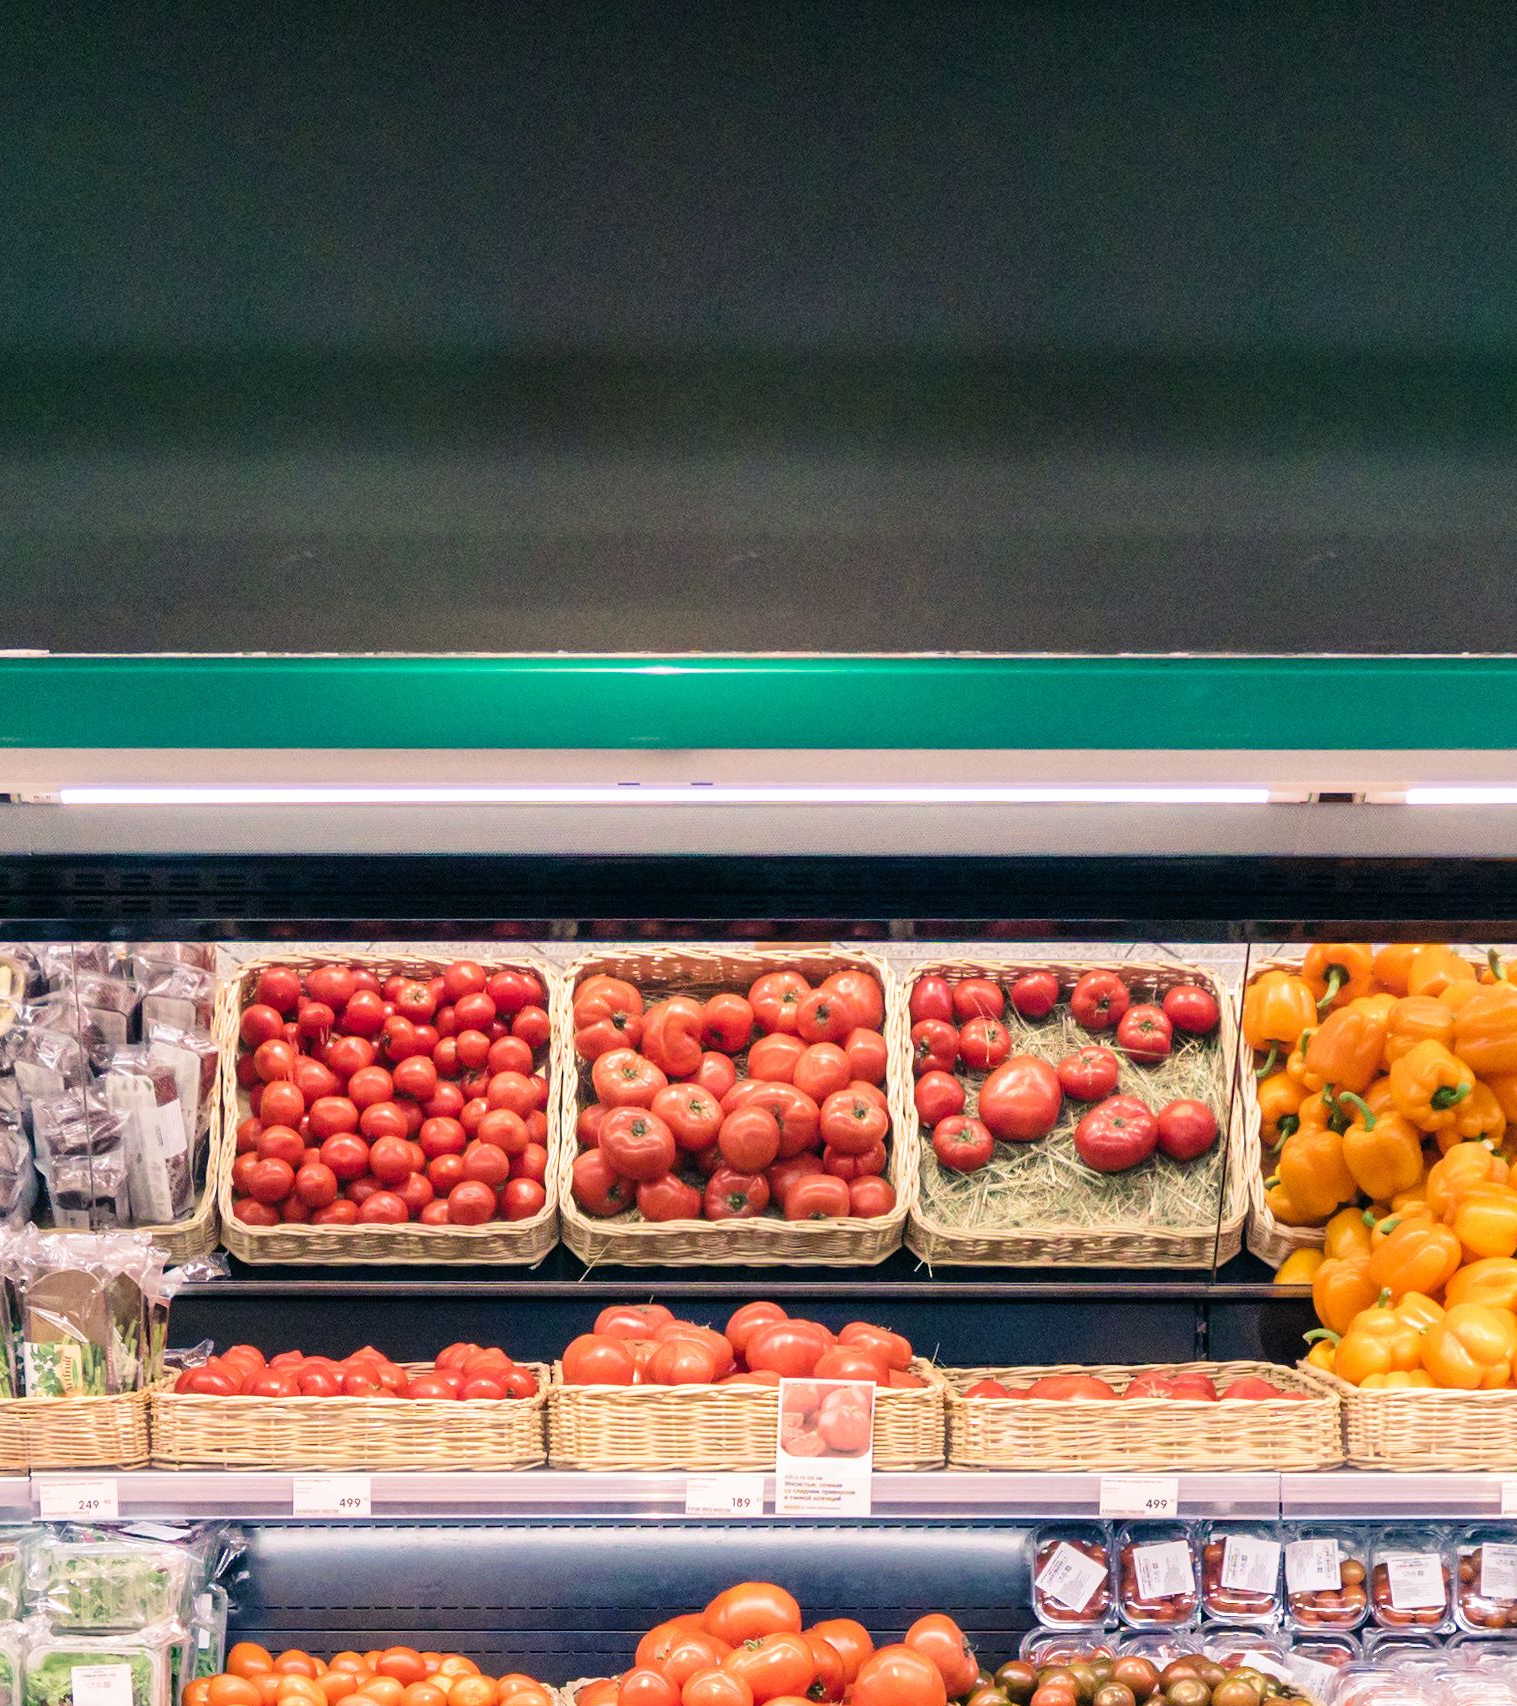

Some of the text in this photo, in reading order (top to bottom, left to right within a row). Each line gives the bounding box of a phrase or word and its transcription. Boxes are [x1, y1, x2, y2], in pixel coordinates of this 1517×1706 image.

[78, 1499, 99, 1509] 249
[339, 1497, 361, 1508] 499
[731, 1497, 751, 1507] 189
[1145, 1499, 1168, 1509] 499
